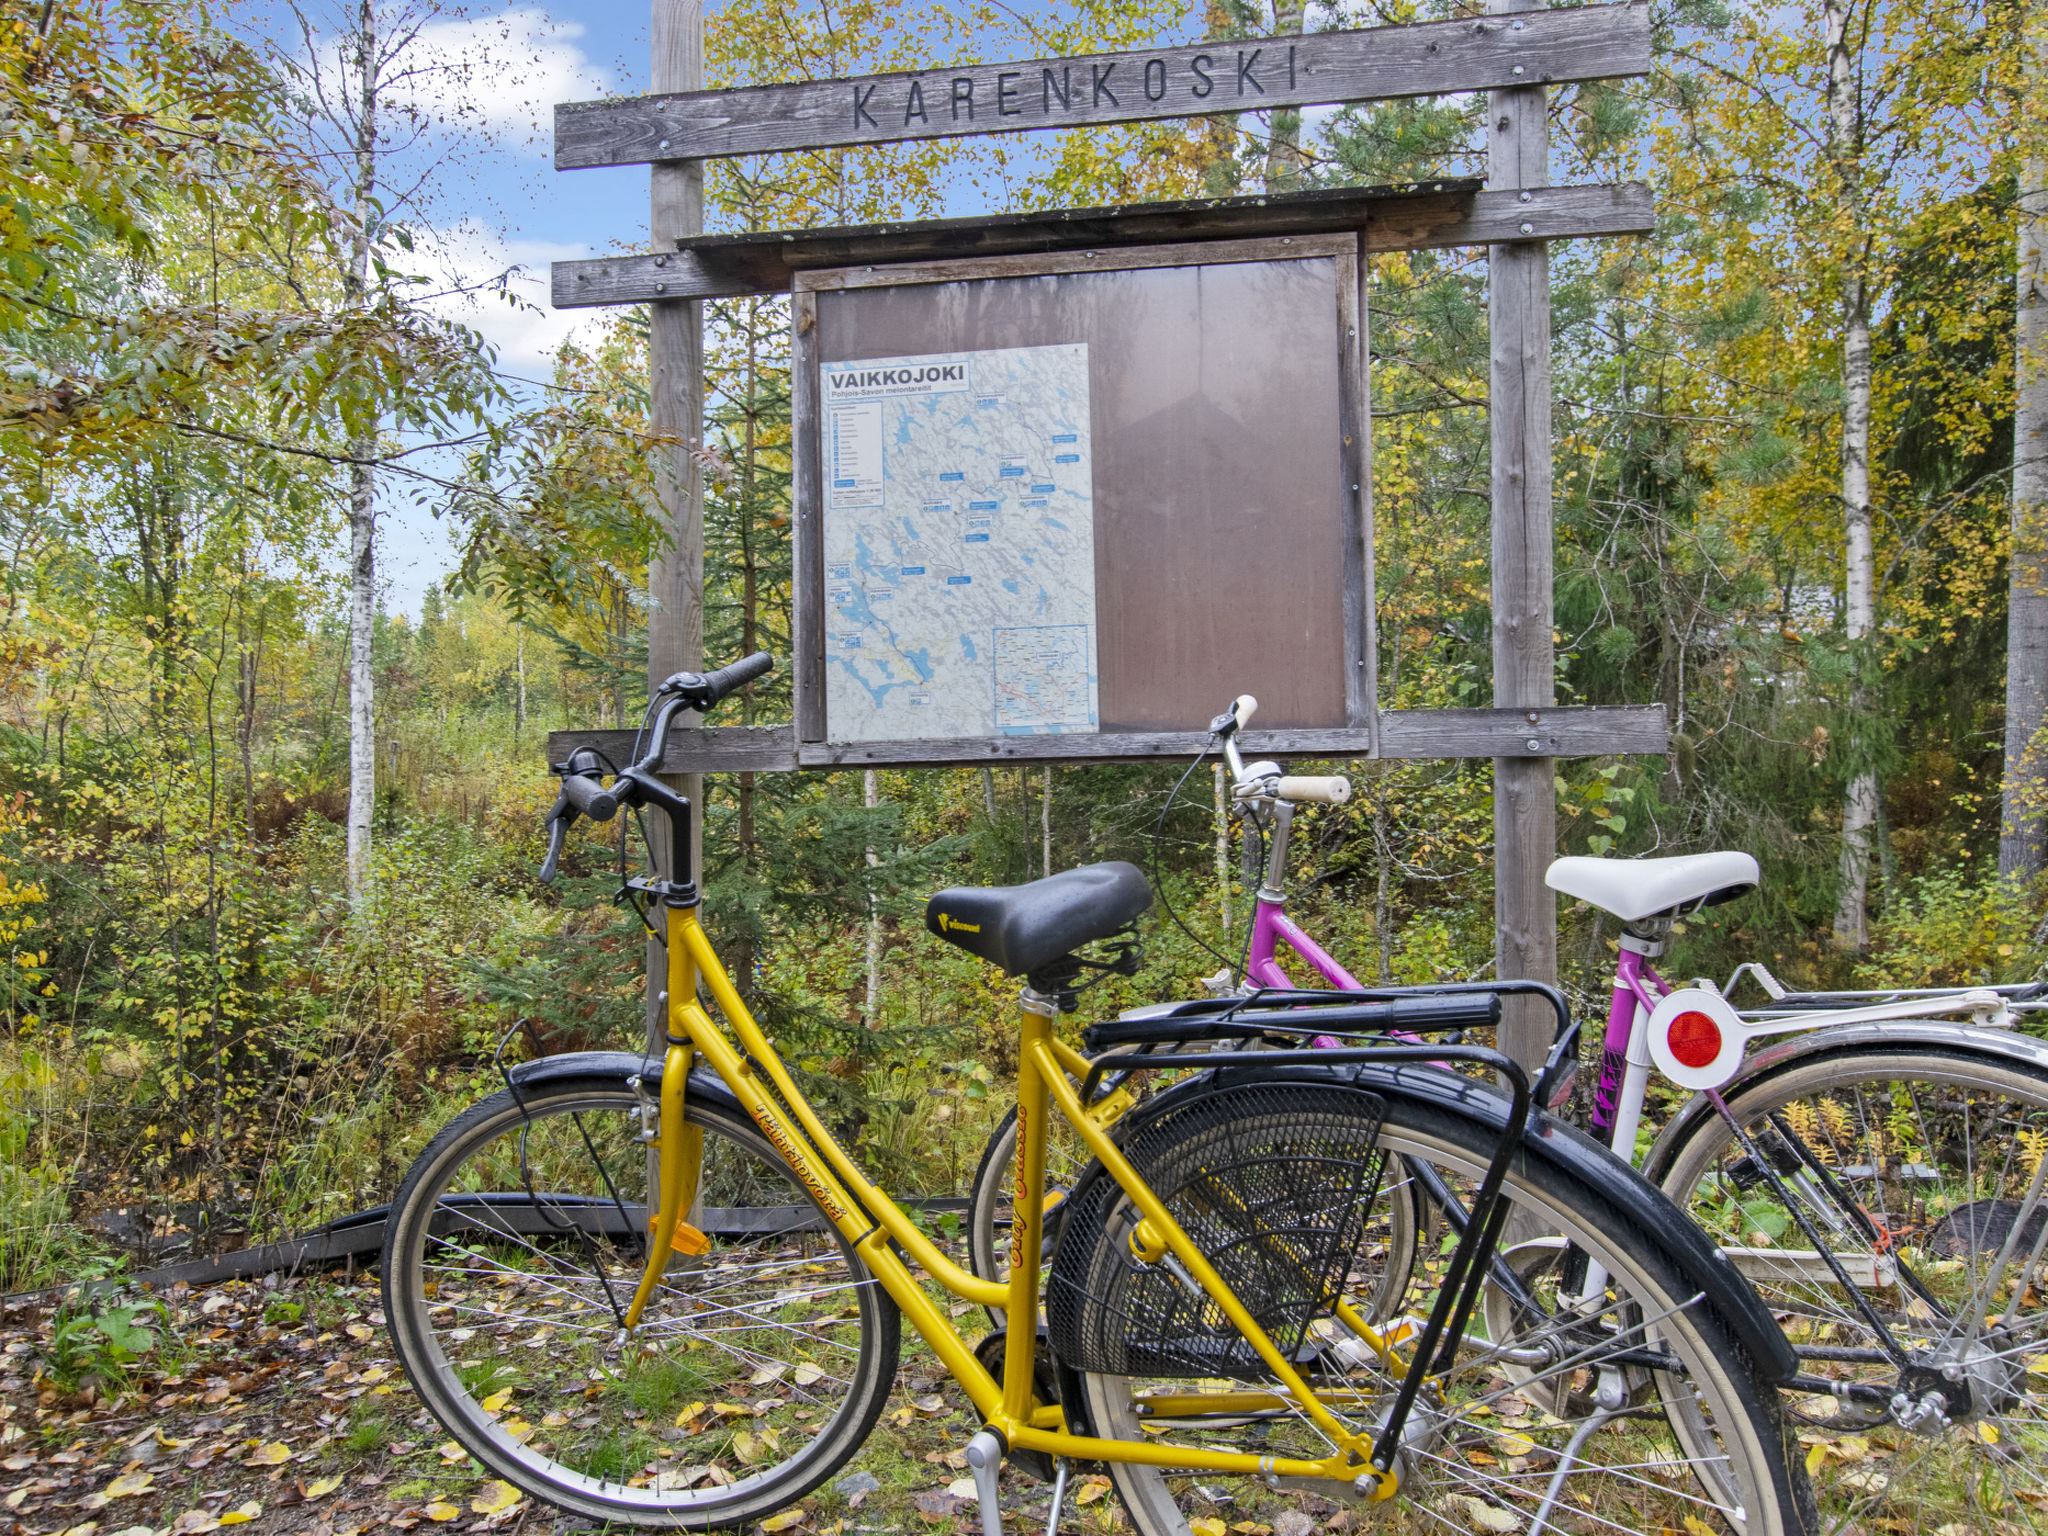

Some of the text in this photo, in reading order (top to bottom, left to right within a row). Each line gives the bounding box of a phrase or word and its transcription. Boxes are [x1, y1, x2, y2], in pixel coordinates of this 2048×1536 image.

[853, 45, 1297, 129] KÄRENKOSKI
[830, 365, 964, 389] VAIKKOJOKI
[831, 388, 884, 398] Pohjois-Savon
[750, 1103, 848, 1223] Tähtipyörä
